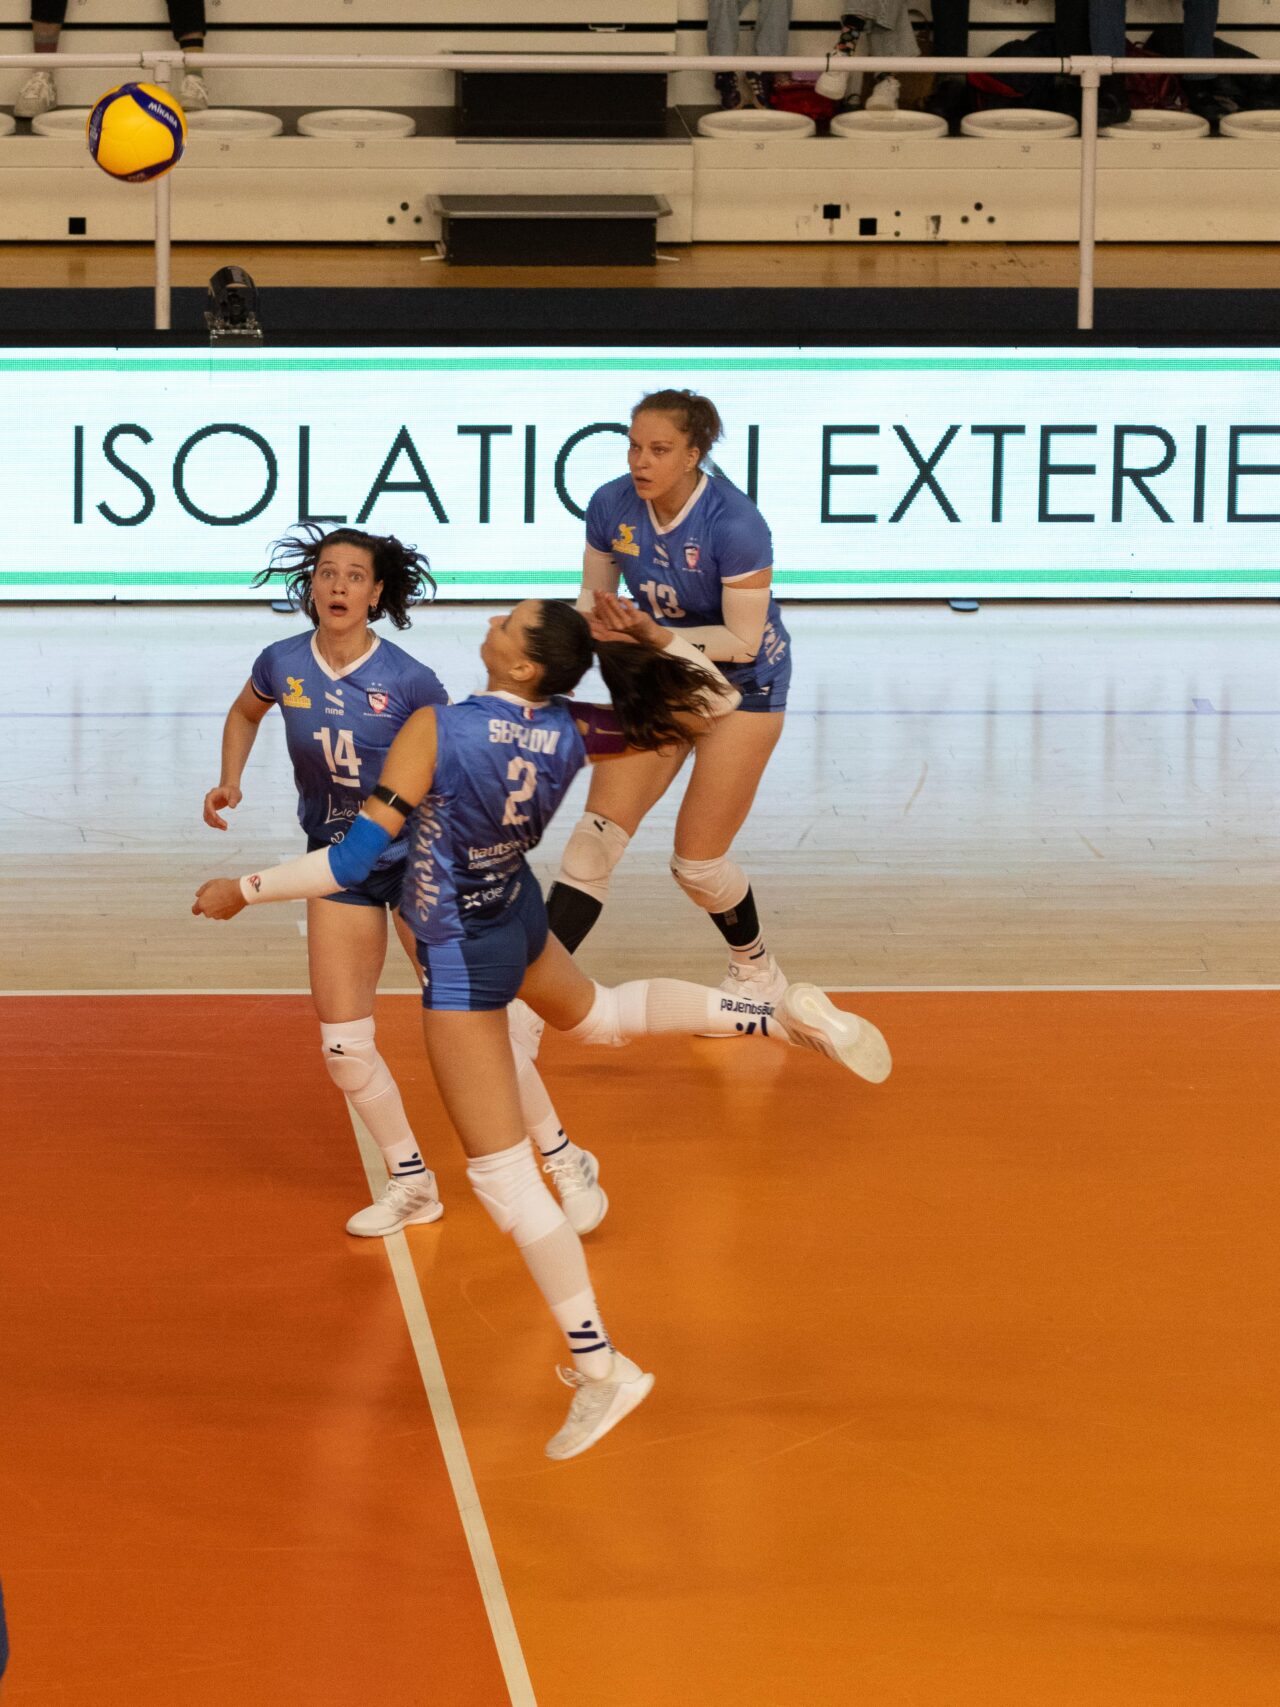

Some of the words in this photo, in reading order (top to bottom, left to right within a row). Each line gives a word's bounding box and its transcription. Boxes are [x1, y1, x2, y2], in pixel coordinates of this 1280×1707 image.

[639, 580, 687, 619] 13
[325, 707, 344, 715] nine
[313, 727, 362, 776] 14
[502, 756, 538, 826] 2
